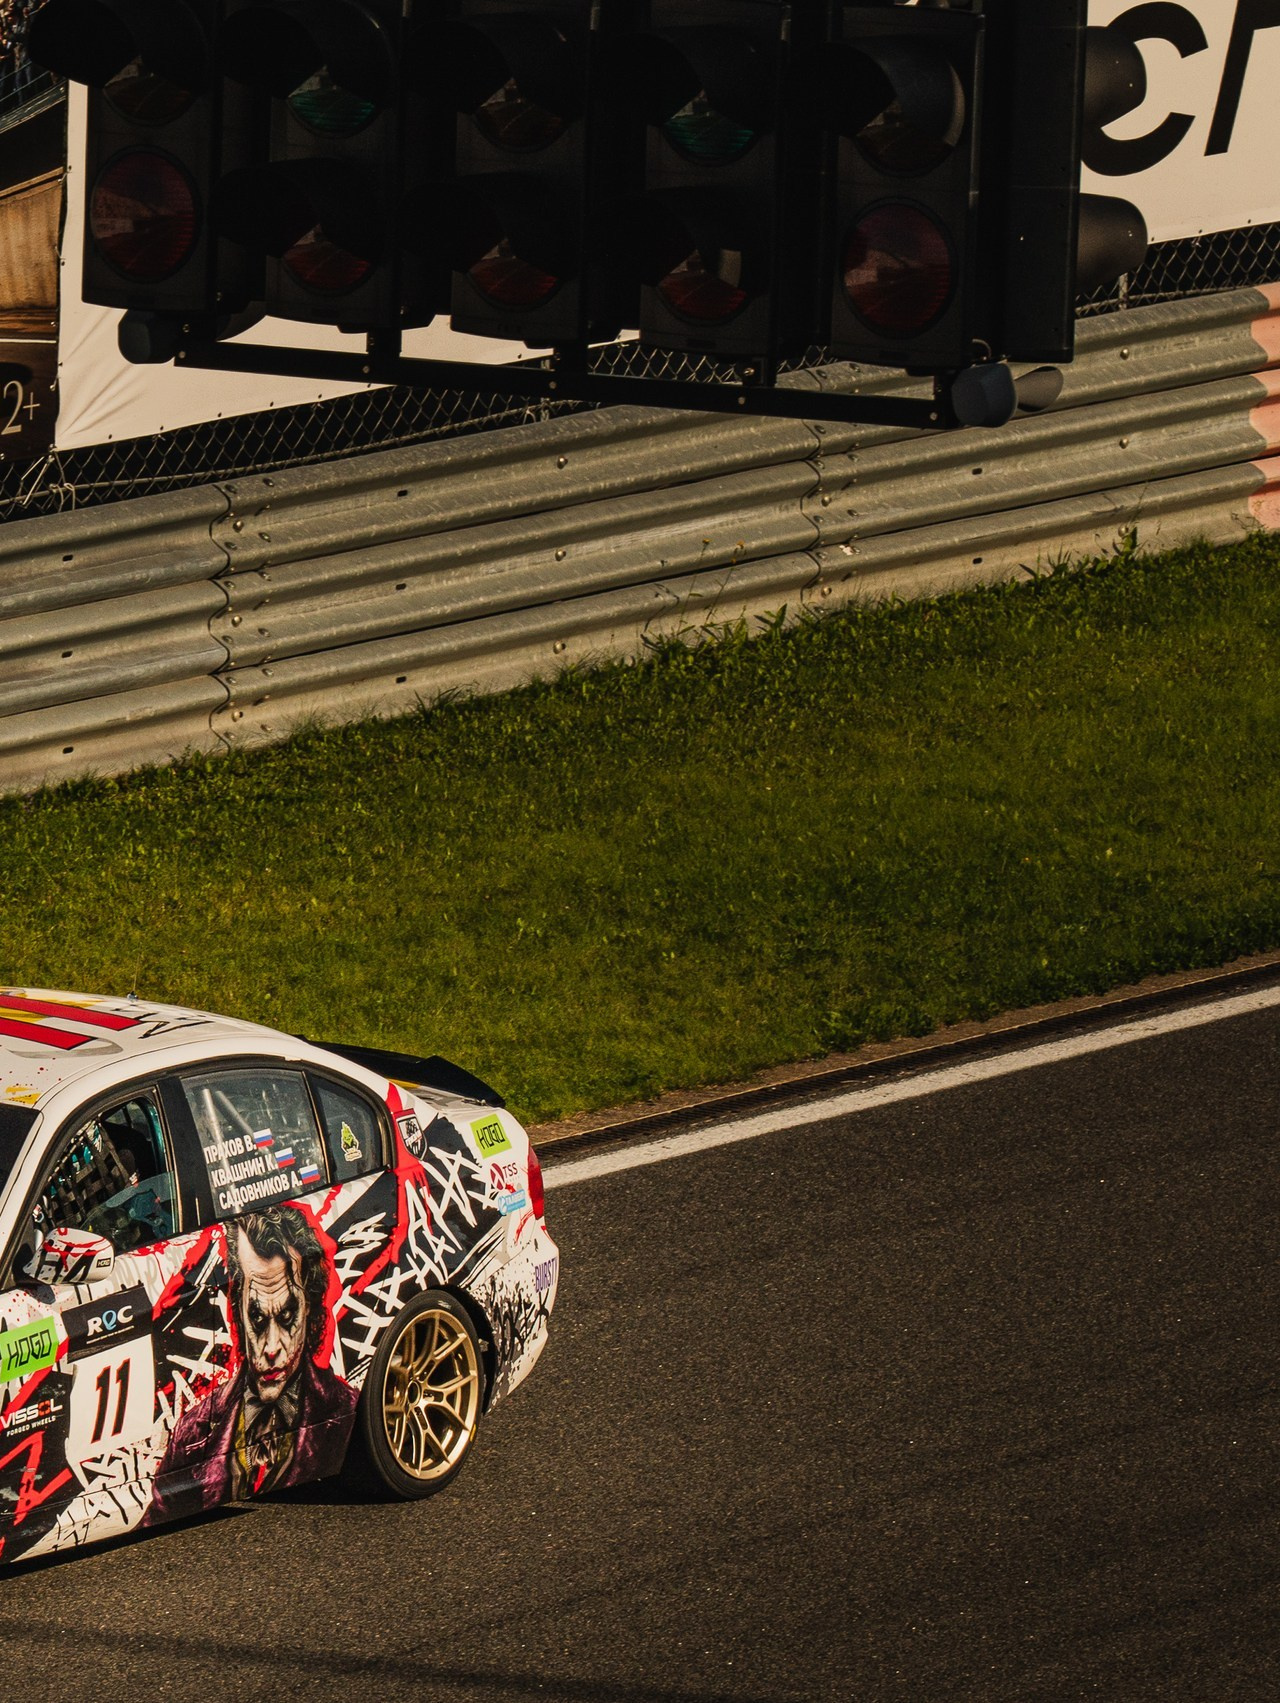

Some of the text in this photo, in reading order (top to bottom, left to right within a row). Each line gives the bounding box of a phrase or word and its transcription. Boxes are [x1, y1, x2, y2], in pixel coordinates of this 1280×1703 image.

[475, 1122, 506, 1150] HOGO
[203, 1138, 243, 1164] ПРАХОВ
[211, 1158, 266, 1188] КВАШНИН
[504, 1162, 519, 1181] TSS
[219, 1174, 290, 1210] САДОВНИКОВ
[6, 1328, 53, 1371] HOGO
[90, 1357, 131, 1444] 11
[6, 1415, 57, 1437] FORGED WHEELS
